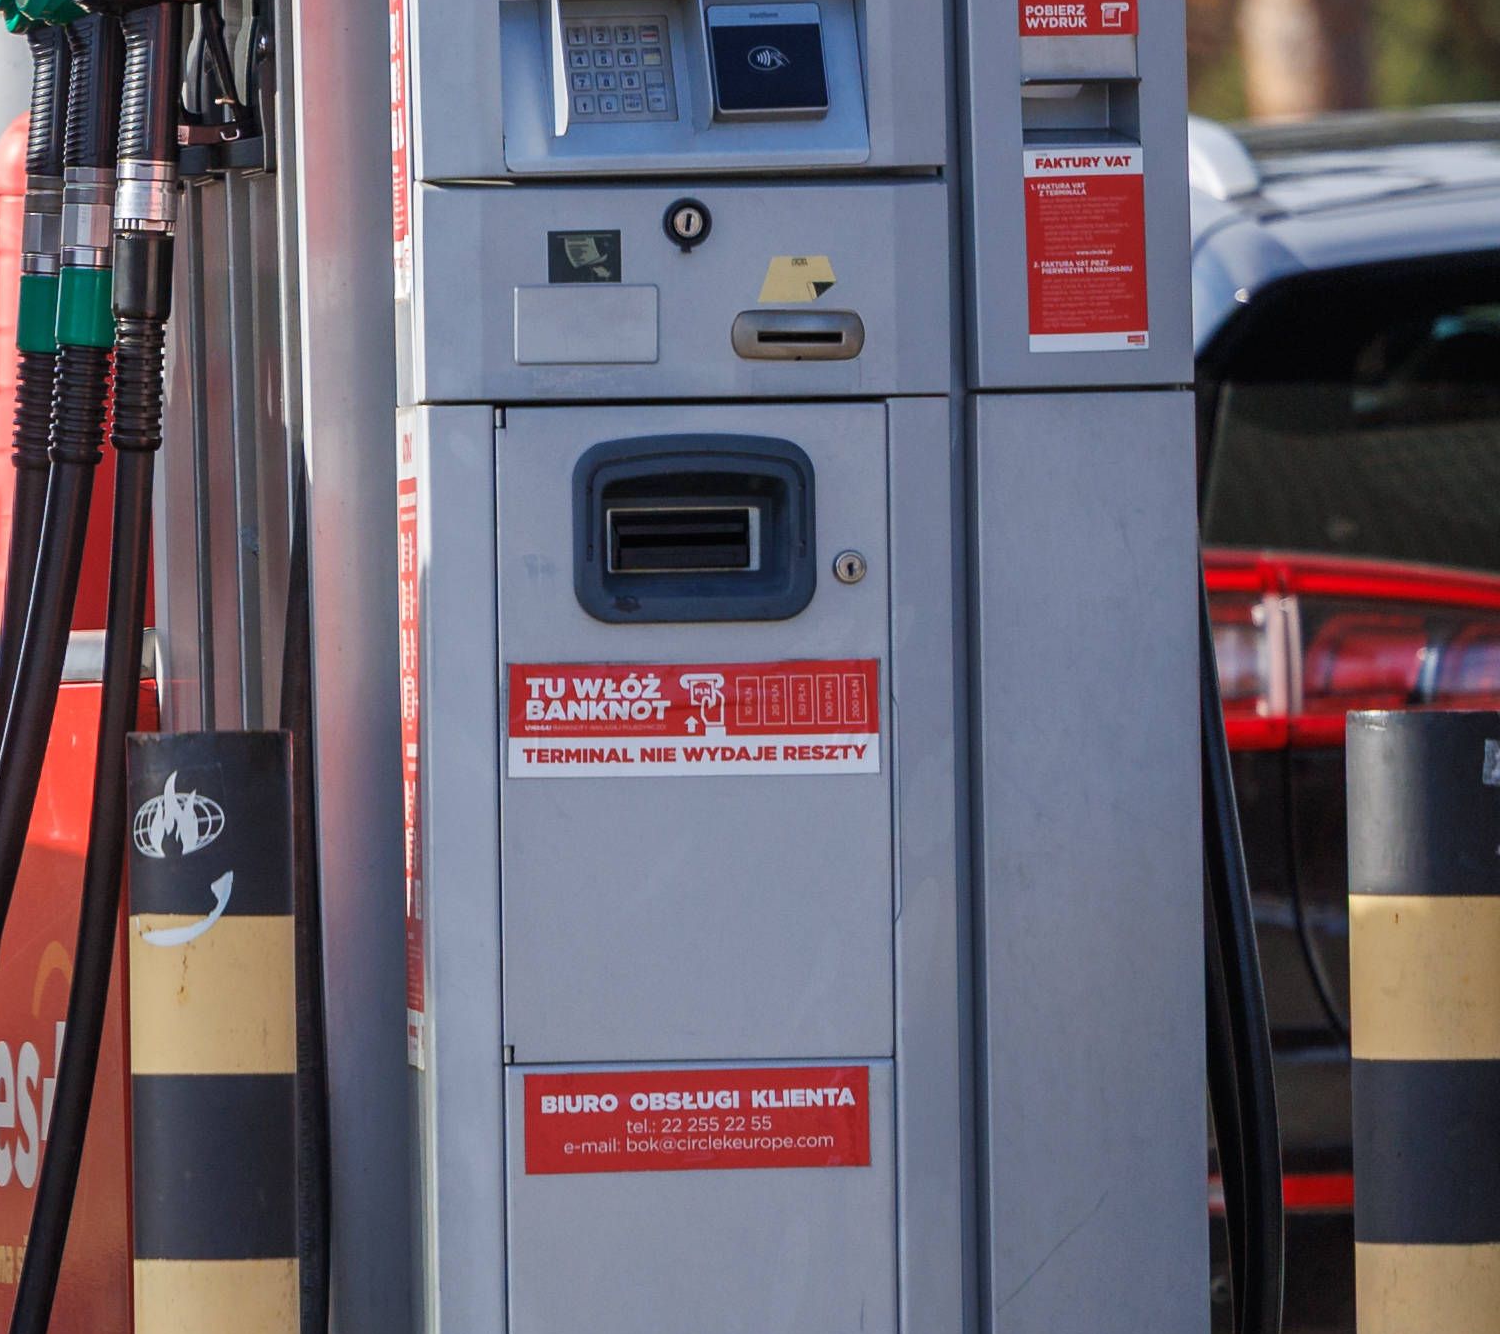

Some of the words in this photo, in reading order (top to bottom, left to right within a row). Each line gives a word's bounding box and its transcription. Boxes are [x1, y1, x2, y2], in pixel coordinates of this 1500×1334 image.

[1025, 4, 1085, 16] POBIERZ
[1026, 17, 1087, 28] WYDRUK
[1035, 157, 1101, 169] FAKTURY
[1104, 156, 1131, 167] VAT
[1086, 265, 1133, 273] TANKOWANIU
[526, 678, 565, 698] TU
[573, 673, 661, 699] WŁÓŻ
[694, 687, 712, 696] PLN
[771, 684, 779, 704] PLN
[526, 700, 671, 721] BANKNOT
[523, 748, 634, 764] TERMINAL
[640, 747, 676, 762] NIE
[683, 746, 777, 762] WYDAJE
[783, 744, 867, 761] RESZTY
[541, 1094, 618, 1114] BIURO
[630, 1090, 739, 1111] OBSŁUGI
[751, 1087, 855, 1108] KLIENTA
[626, 1118, 656, 1134] tel.:
[661, 1118, 682, 1132] 22
[688, 1117, 719, 1132] 255
[725, 1117, 746, 1131] 22
[751, 1116, 772, 1130] 55
[563, 1138, 621, 1154] e-mail:
[626, 1133, 834, 1153] bok@circlekeurope.com
